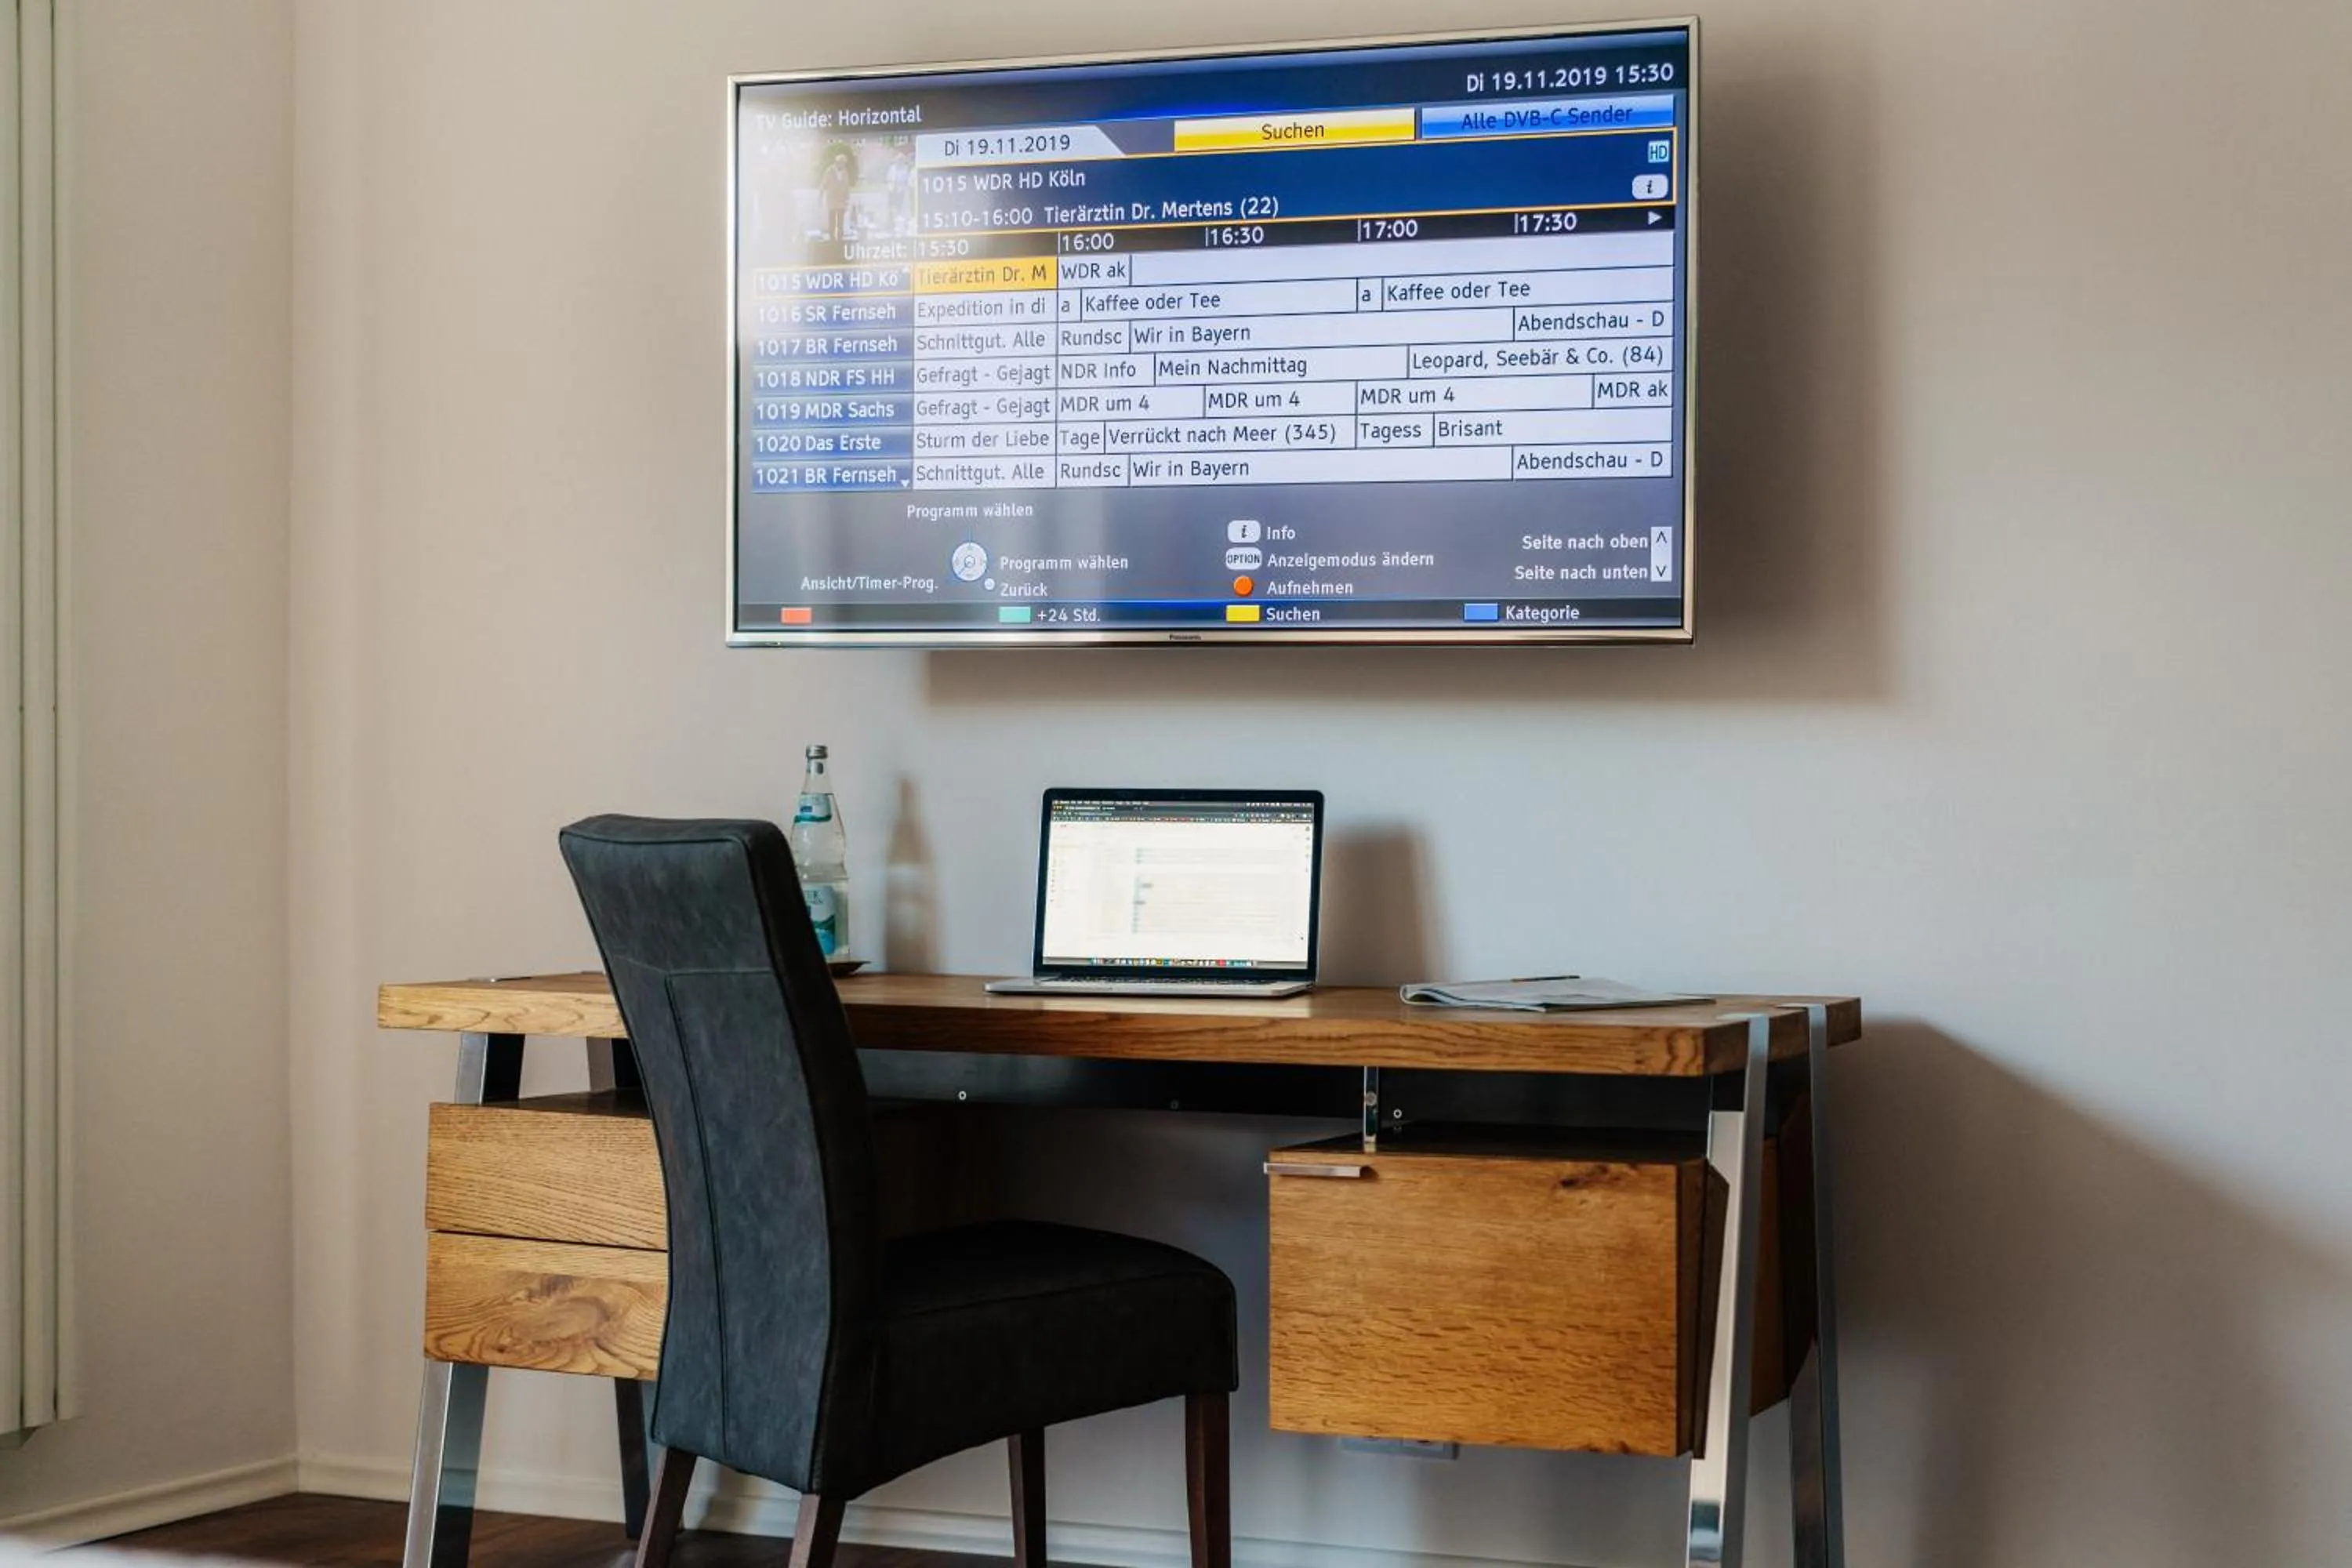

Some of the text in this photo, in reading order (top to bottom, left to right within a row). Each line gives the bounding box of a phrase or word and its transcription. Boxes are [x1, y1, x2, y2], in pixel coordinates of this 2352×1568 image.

[1467, 63, 1674, 93] Di 19.11.2019 15:30
[757, 104, 922, 129] TV Guide: Horizontal
[1461, 105, 1633, 130] Alle DVB-C Sender
[1261, 122, 1324, 140] Suchen
[945, 135, 1070, 156] Di 19.11.2019
[1650, 145, 1668, 160] HD
[923, 169, 1085, 194] 1015 WDR HD Köln
[924, 196, 1279, 228] 15:10-16:00 Tierärztin Dr. Mertens (22)
[1363, 220, 1418, 238] 17:00
[1520, 212, 1577, 233] 17:30
[1062, 233, 1114, 251] 16:00
[1211, 226, 1264, 245] 16:30
[844, 239, 968, 260] Uhrzeit: 15:30
[919, 265, 1047, 285] Tierärztin Dr. M
[1061, 261, 1126, 279] WDR ak
[760, 274, 800, 290] 1015
[806, 274, 844, 289] WDR
[850, 273, 872, 288] HD
[1361, 287, 1371, 302] a
[1388, 281, 1530, 301] Kaffee oder Tee
[918, 297, 1045, 321] Expedition in di
[1061, 300, 1070, 312] a
[1086, 292, 1221, 313] Kaffee oder Tee
[759, 304, 895, 322] 1016 SR Fernseh
[1518, 313, 1629, 332] Abendschau
[1652, 311, 1664, 327] D
[917, 330, 1045, 353] Schnittgut. Alle
[1062, 329, 1122, 346] Rundsc
[1134, 325, 1250, 345] Wir in Bayern
[758, 336, 897, 356] 1017 BR Fernseh
[1159, 358, 1308, 376] Mein Nachmittag
[1413, 345, 1664, 371] Leopard, Seebär & Co. (84)
[757, 368, 895, 388] 1018 NDR FS HH
[916, 366, 978, 387] Gefragt
[997, 364, 1051, 385] Gejagt
[1061, 361, 1136, 379] NDR Info
[1360, 387, 1455, 406] MDR um 4
[1597, 381, 1668, 399] MDR ak
[916, 399, 978, 419] Gefragt
[997, 397, 1051, 418] Gejagt
[1060, 395, 1149, 412] MDR um 4
[1208, 391, 1301, 408] MDR um 4
[757, 401, 895, 419] 1019 MDR Sachs
[1109, 423, 1336, 445] Verrückt nach Meer (345)
[1360, 422, 1421, 441] Tagess
[1439, 419, 1503, 437] Brisant
[757, 434, 881, 452] 1020 Das Erste
[916, 430, 1049, 448] Sturm der Liebe
[1060, 430, 1100, 450] Tage
[1061, 462, 1121, 478] Rundsc
[1517, 452, 1627, 470] Abendschau
[1651, 452, 1663, 466] D
[757, 466, 897, 485] 1021 BR Fernseh
[916, 463, 1044, 485] Schnittgut. Alle
[1133, 461, 1249, 480] Wir in Bayern
[907, 503, 1033, 521] Programm wählen
[1266, 525, 1296, 540] Info
[1522, 534, 1648, 550] Seite nach oben
[1000, 555, 1129, 573] Programm wählen
[1227, 554, 1260, 564] OPTION
[1382, 551, 1434, 566] ändern
[1515, 564, 1648, 580] Seite nach unten
[800, 576, 938, 593] Ansicht/Timer-Prog.
[1000, 583, 1048, 597] Zurück
[1266, 580, 1354, 595] Aufnehmen
[1037, 608, 1101, 622] +24 Std.
[1266, 608, 1320, 621] Suchen
[1505, 605, 1580, 623] Kategorie
